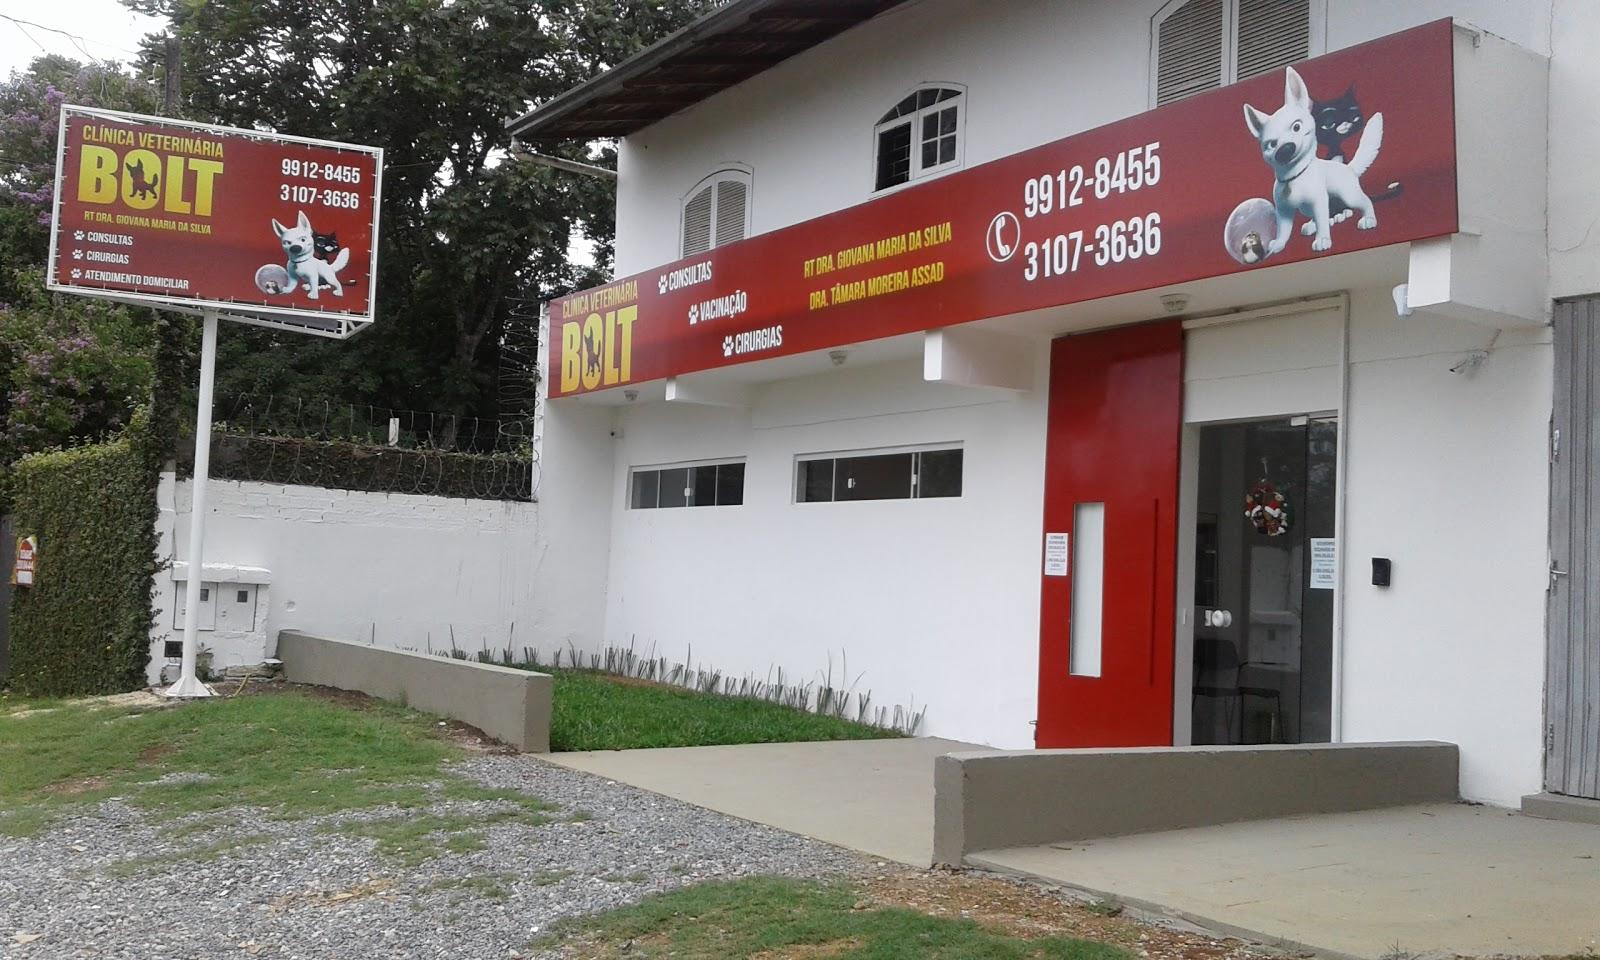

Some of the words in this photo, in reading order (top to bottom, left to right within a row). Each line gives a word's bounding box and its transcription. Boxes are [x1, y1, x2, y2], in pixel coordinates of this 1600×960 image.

[83, 125, 134, 146] CLÍNICA
[139, 132, 224, 158] VETERINÁRIA
[78, 144, 224, 217] BOLT
[282, 159, 361, 184] 9912-8455
[1025, 142, 1160, 218] 9912-8455
[280, 184, 360, 209] 3107-3636
[84, 211, 94, 221] RT
[96, 212, 113, 224] DRA.
[116, 215, 150, 227] GIOVANA
[151, 219, 176, 231] MARIA
[178, 222, 188, 232] DA
[190, 224, 211, 235] SILVA
[87, 231, 133, 246] CONSULTAS
[86, 250, 129, 264] CIRURGIAS
[804, 259, 815, 278] RT
[816, 254, 836, 275] DRA.
[838, 243, 874, 269] GIOVANA
[877, 234, 906, 260] MARIA
[909, 230, 922, 251] DA
[924, 222, 952, 247] SILVA
[1024, 212, 1161, 281] 3107-3636
[84, 269, 142, 285] ATENDIMENTO
[143, 275, 189, 290] DOMICILIAR
[669, 260, 712, 291] CONSULTAS
[810, 289, 829, 310] DRA.
[831, 282, 866, 305] TÂMARA
[868, 270, 909, 297] MOREIRA
[911, 261, 944, 287] ASSAD
[590, 280, 638, 310] VETERINÁRIA
[700, 289, 747, 322] VACINAÇÃO
[561, 304, 638, 393] BOLT
[735, 325, 783, 354] CIRURGIAS
